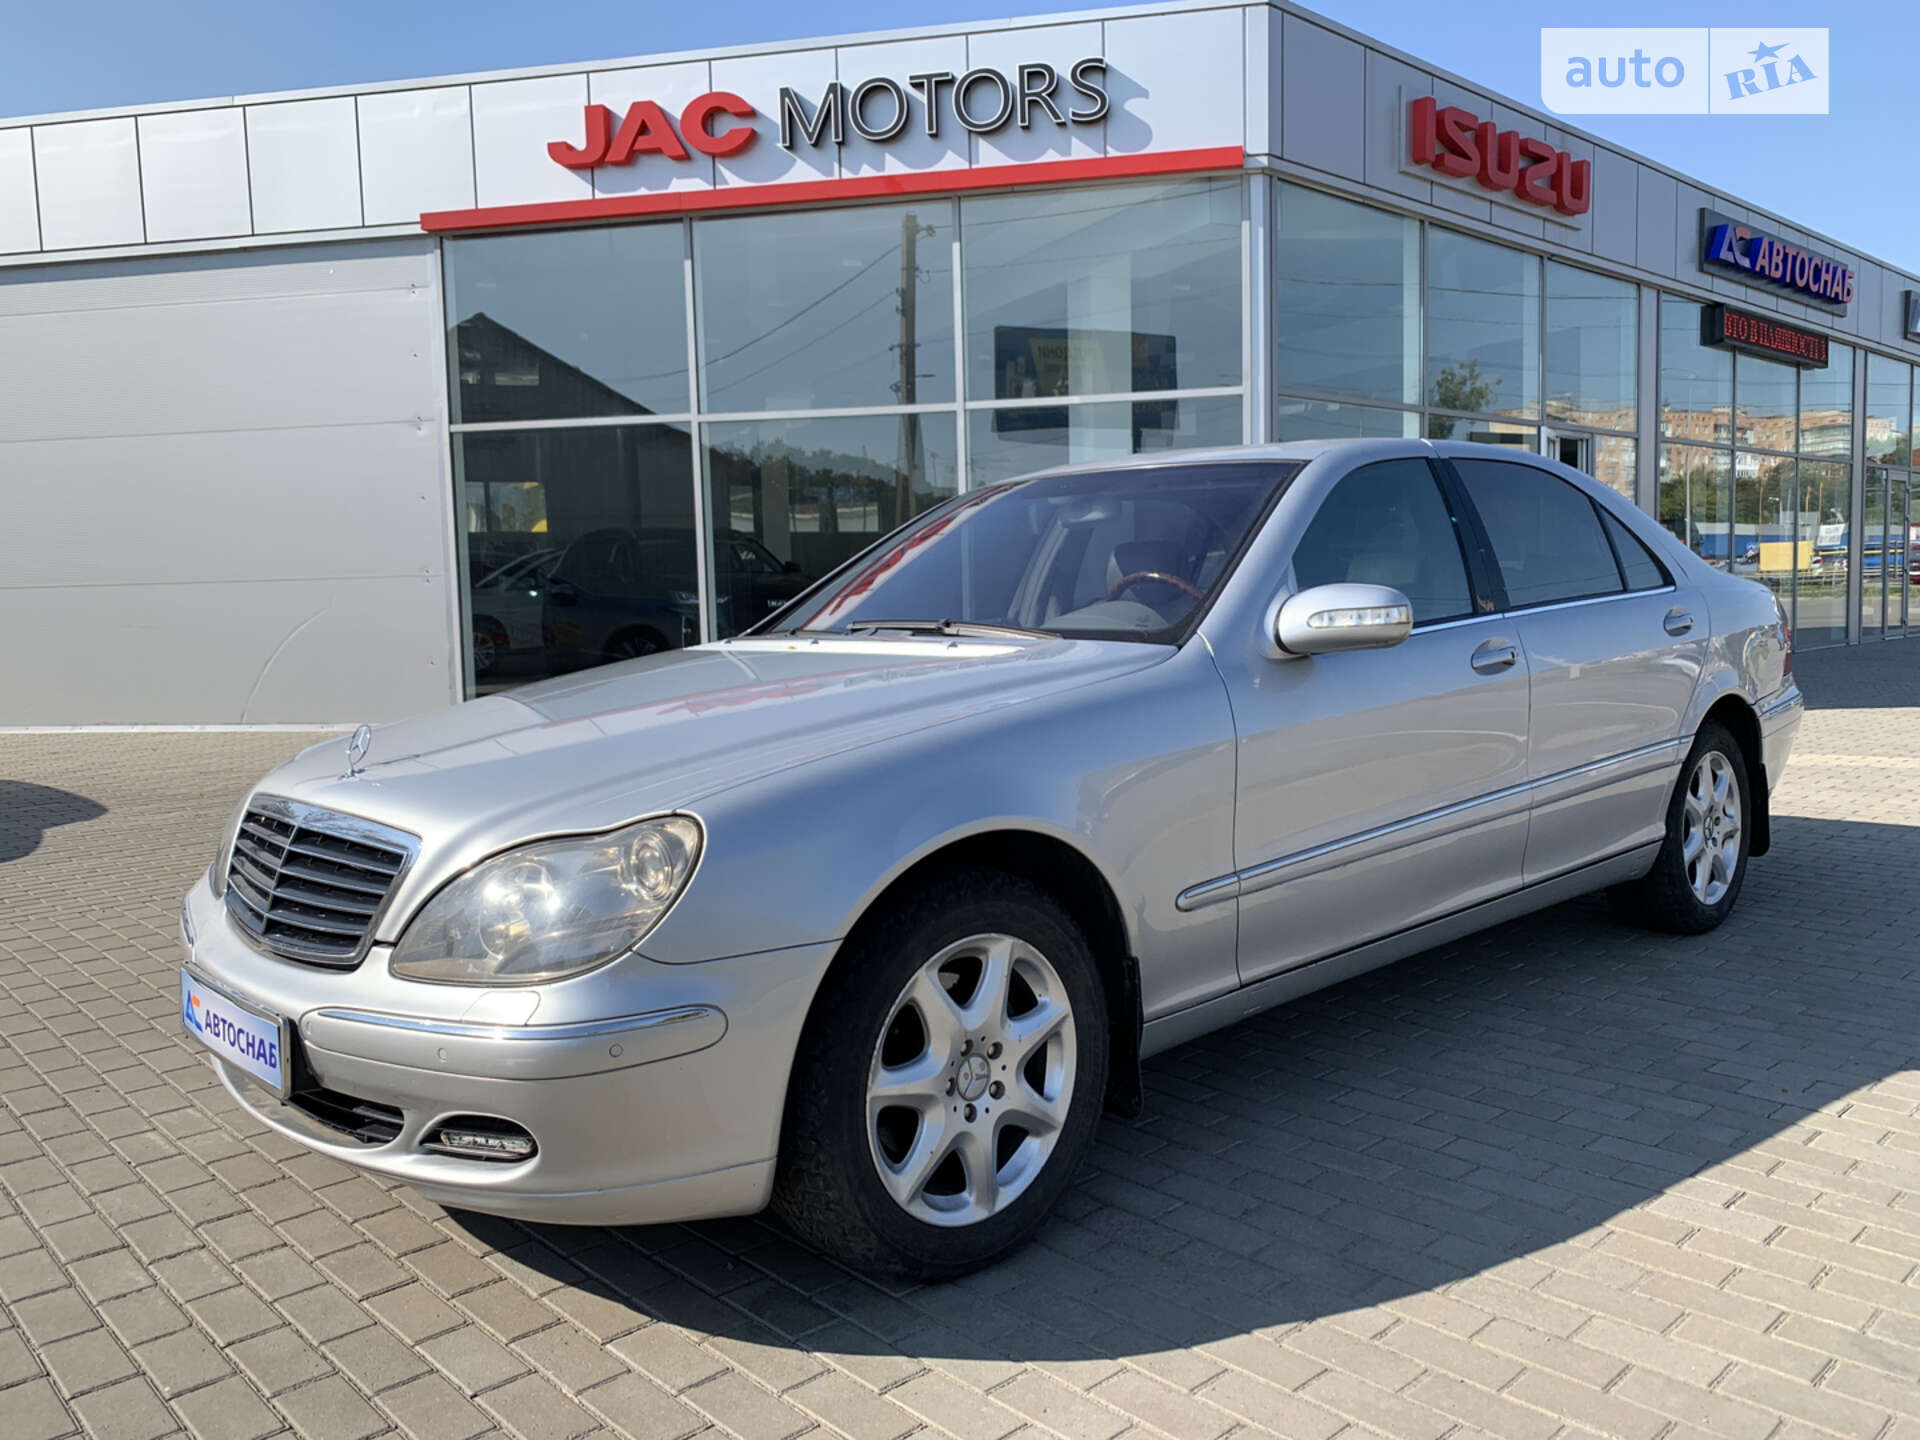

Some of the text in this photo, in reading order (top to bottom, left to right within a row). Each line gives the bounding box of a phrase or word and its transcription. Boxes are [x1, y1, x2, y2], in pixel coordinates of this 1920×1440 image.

[547, 57, 1110, 169] JAC MOTORS
[1412, 97, 1591, 216] ISUZU
[1756, 236, 1855, 303] АВТОСНАБ
[205, 1010, 277, 1069] АВТОСНАБ
